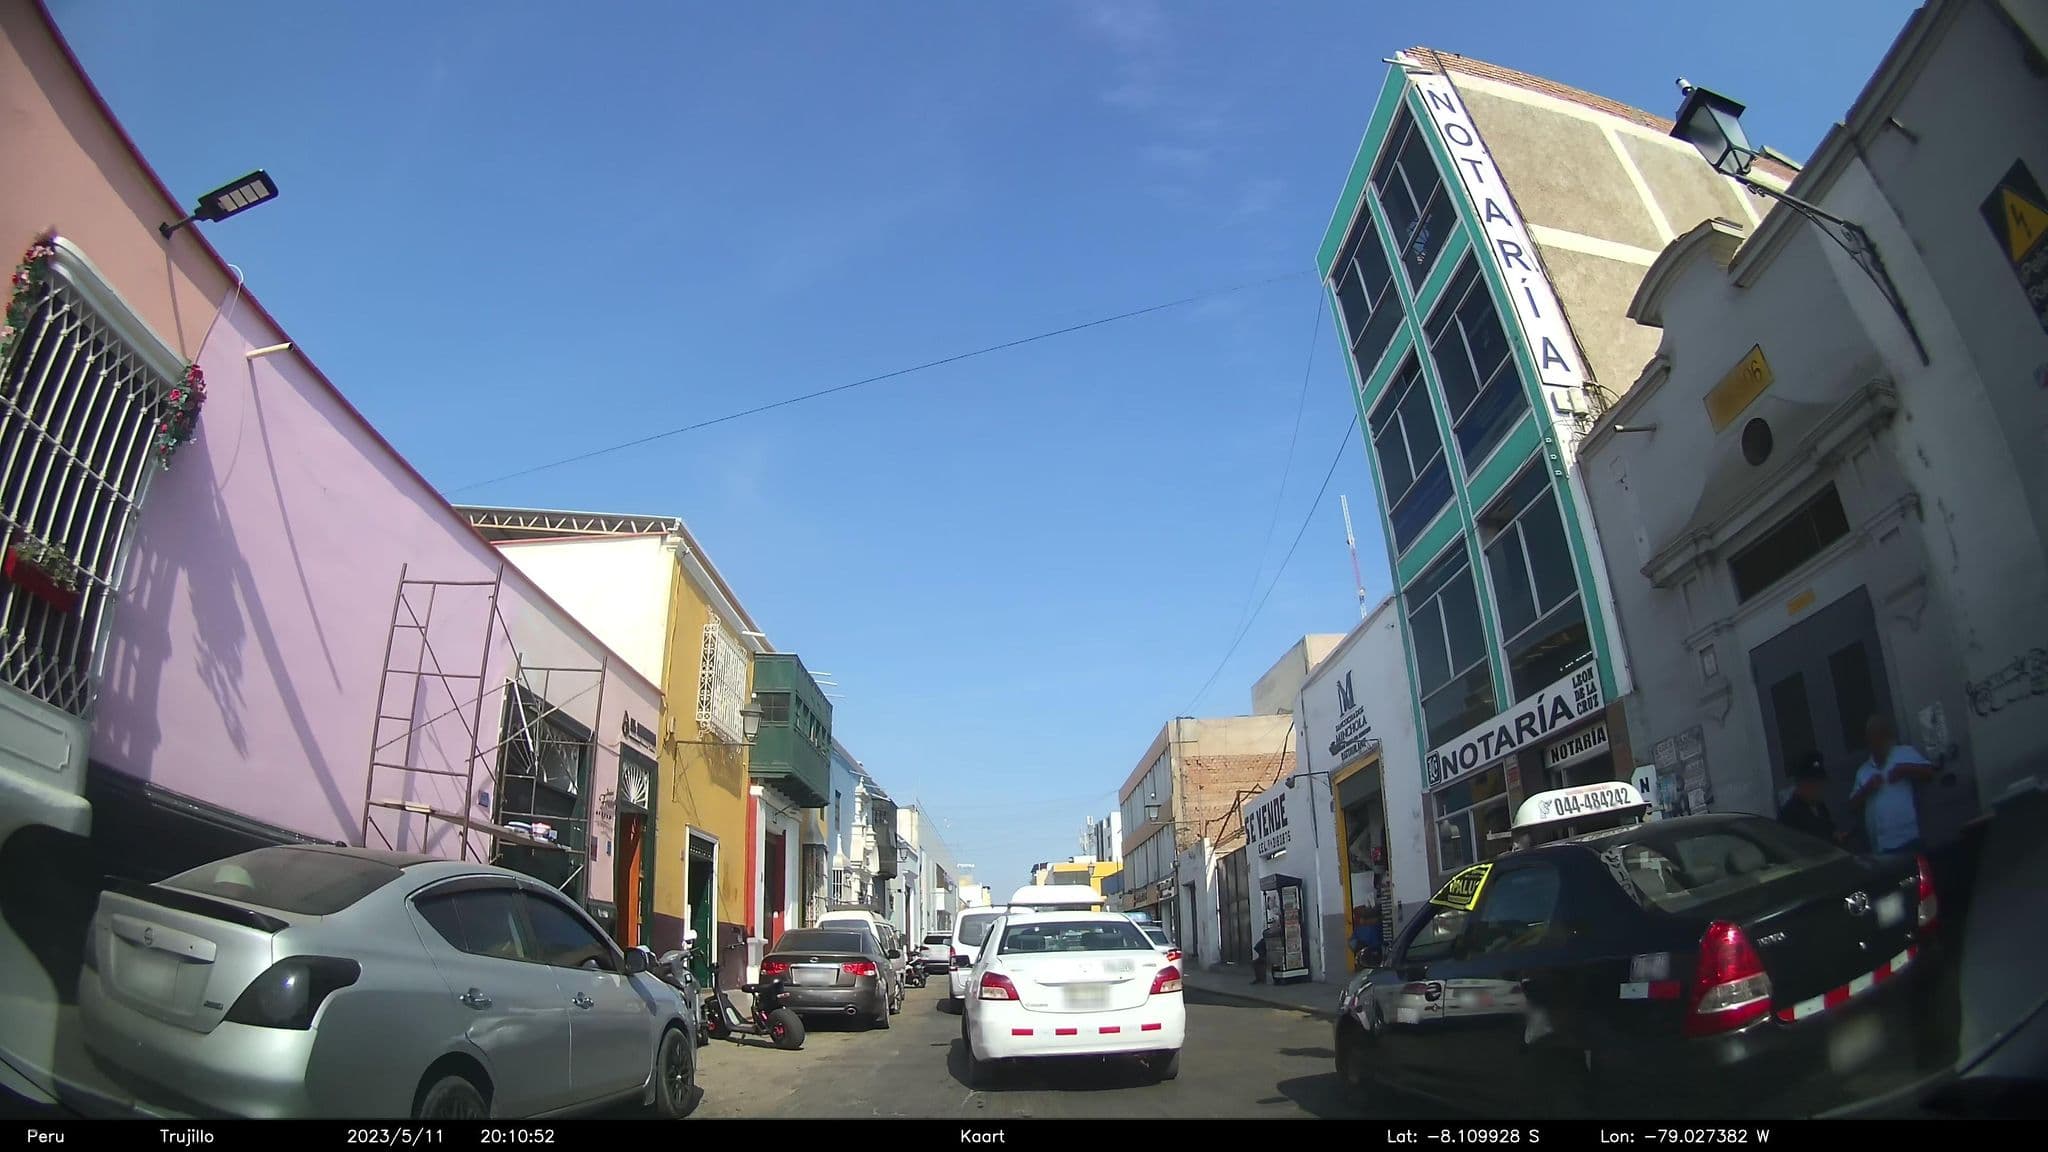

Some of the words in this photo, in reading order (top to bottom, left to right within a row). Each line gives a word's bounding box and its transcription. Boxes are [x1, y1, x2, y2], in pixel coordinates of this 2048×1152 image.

[1426, 89, 1571, 373] NOTARÍA
[1572, 667, 1593, 689] LEON
[1574, 687, 1585, 702] DE
[1586, 681, 1597, 694] LA
[1576, 693, 1599, 715] CRUZ
[1443, 693, 1575, 780] NOTARÍA
[1554, 788, 1631, 816] 044-484242
[1245, 812, 1256, 845] SE
[1256, 792, 1288, 839] VENDE
